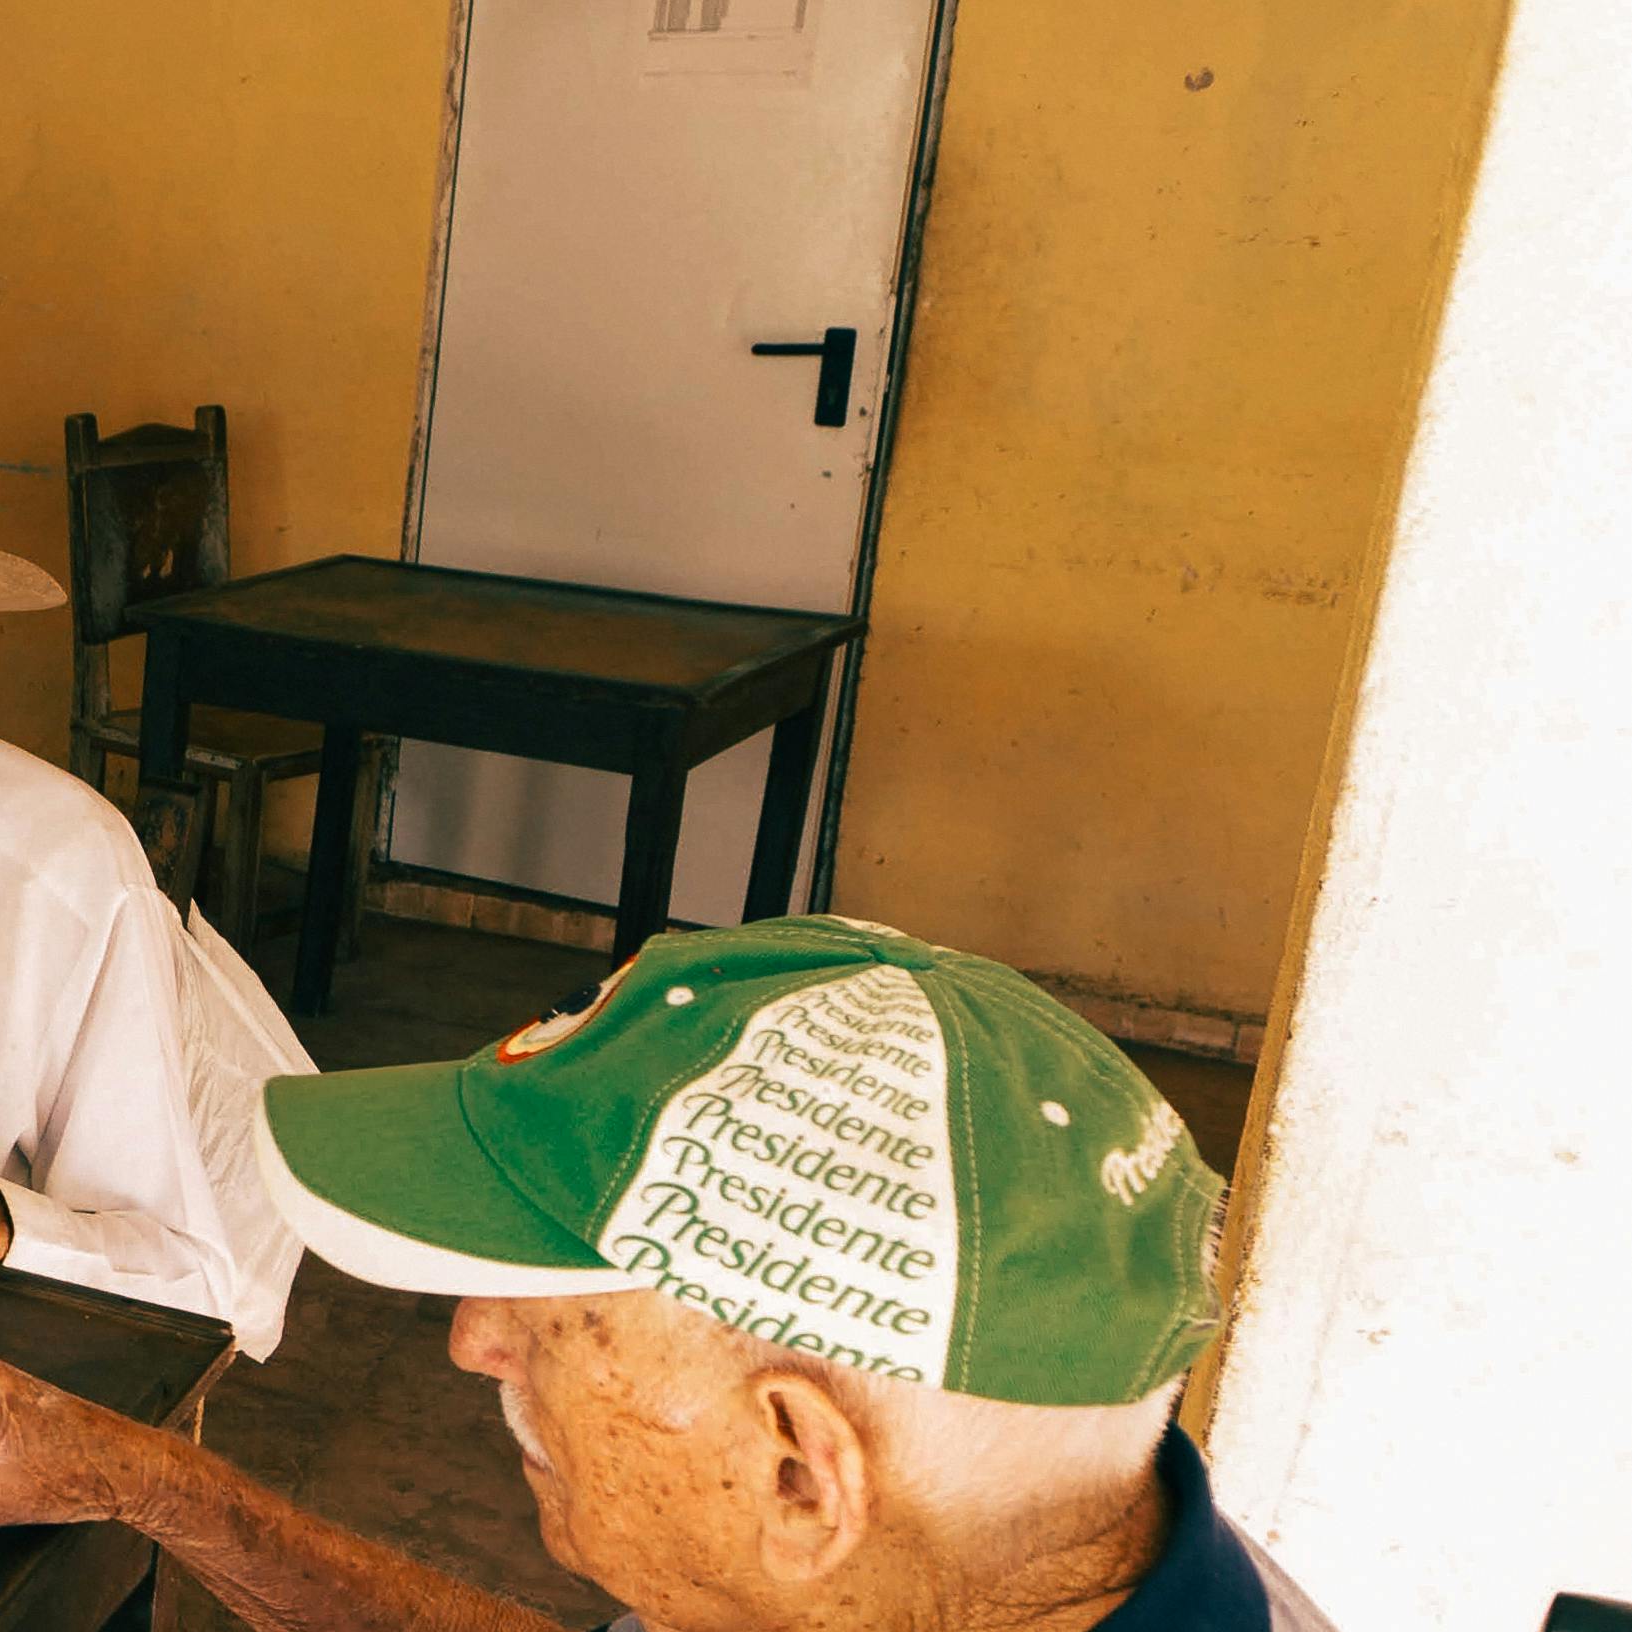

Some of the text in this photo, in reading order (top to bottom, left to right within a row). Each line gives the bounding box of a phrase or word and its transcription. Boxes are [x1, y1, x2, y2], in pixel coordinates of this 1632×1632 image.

[751, 1029, 929, 1121] Presidente
[772, 1004, 931, 1078] Presidente
[683, 1092, 936, 1220] Presidente
[719, 1063, 934, 1170] Presidente
[640, 1181, 931, 1336] Presidente
[662, 1135, 936, 1280] Presidente
